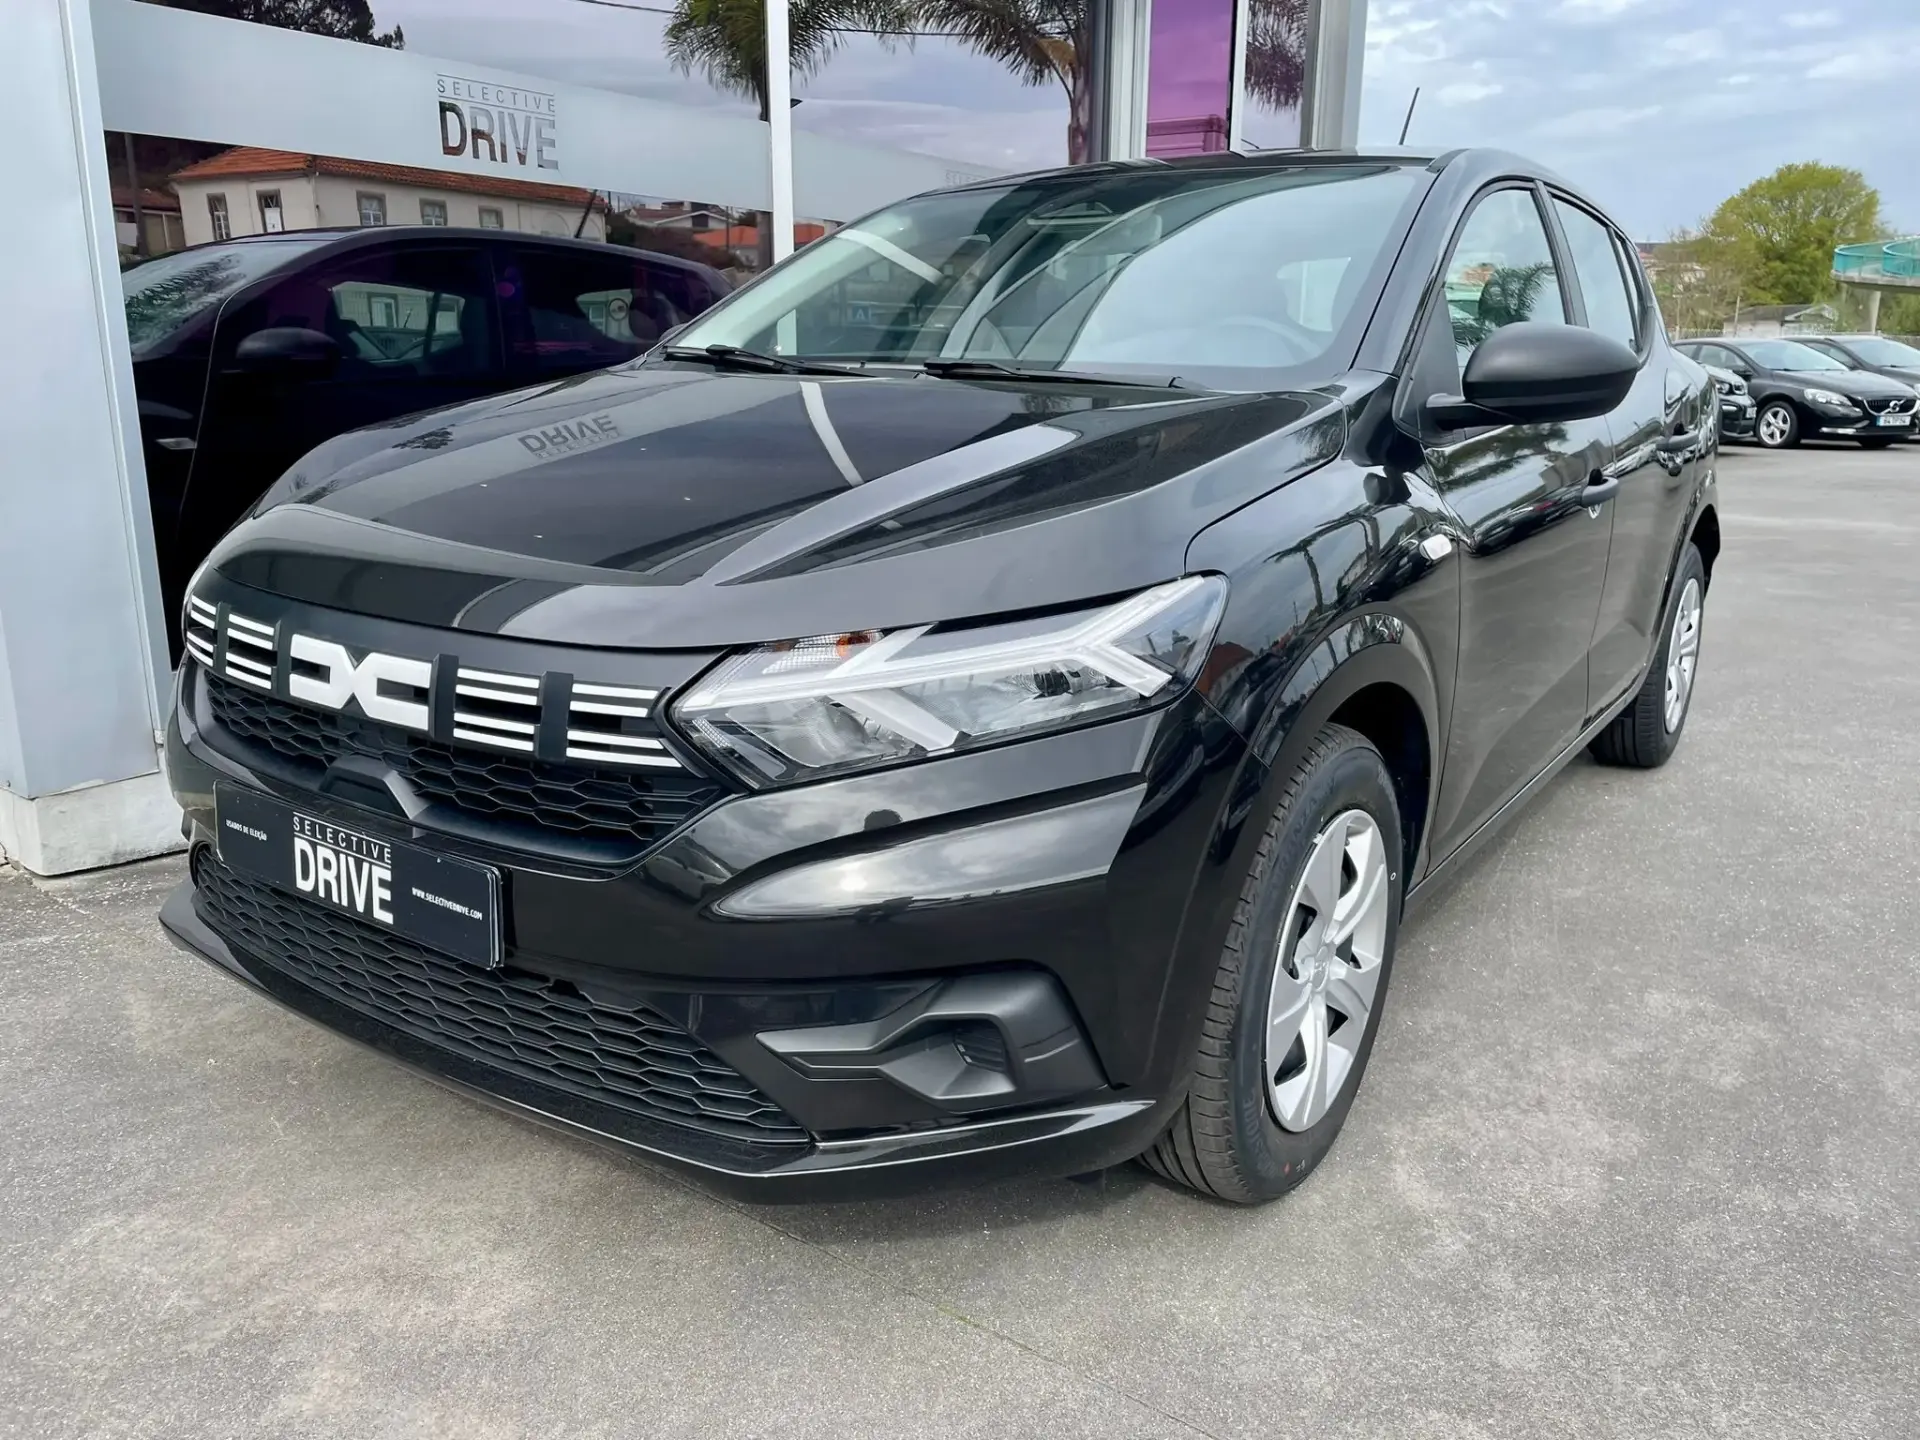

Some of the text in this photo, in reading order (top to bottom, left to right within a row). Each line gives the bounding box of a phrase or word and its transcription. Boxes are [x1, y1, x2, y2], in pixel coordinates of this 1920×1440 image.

[436, 79, 556, 113] SELECTIVE
[438, 101, 559, 170] DRIVE
[225, 819, 243, 832] USADOS
[293, 816, 392, 864] SELECTIVE
[294, 837, 394, 925] DRIVE
[411, 886, 483, 921] WWW.SELECTIVEDRIVE.COM
